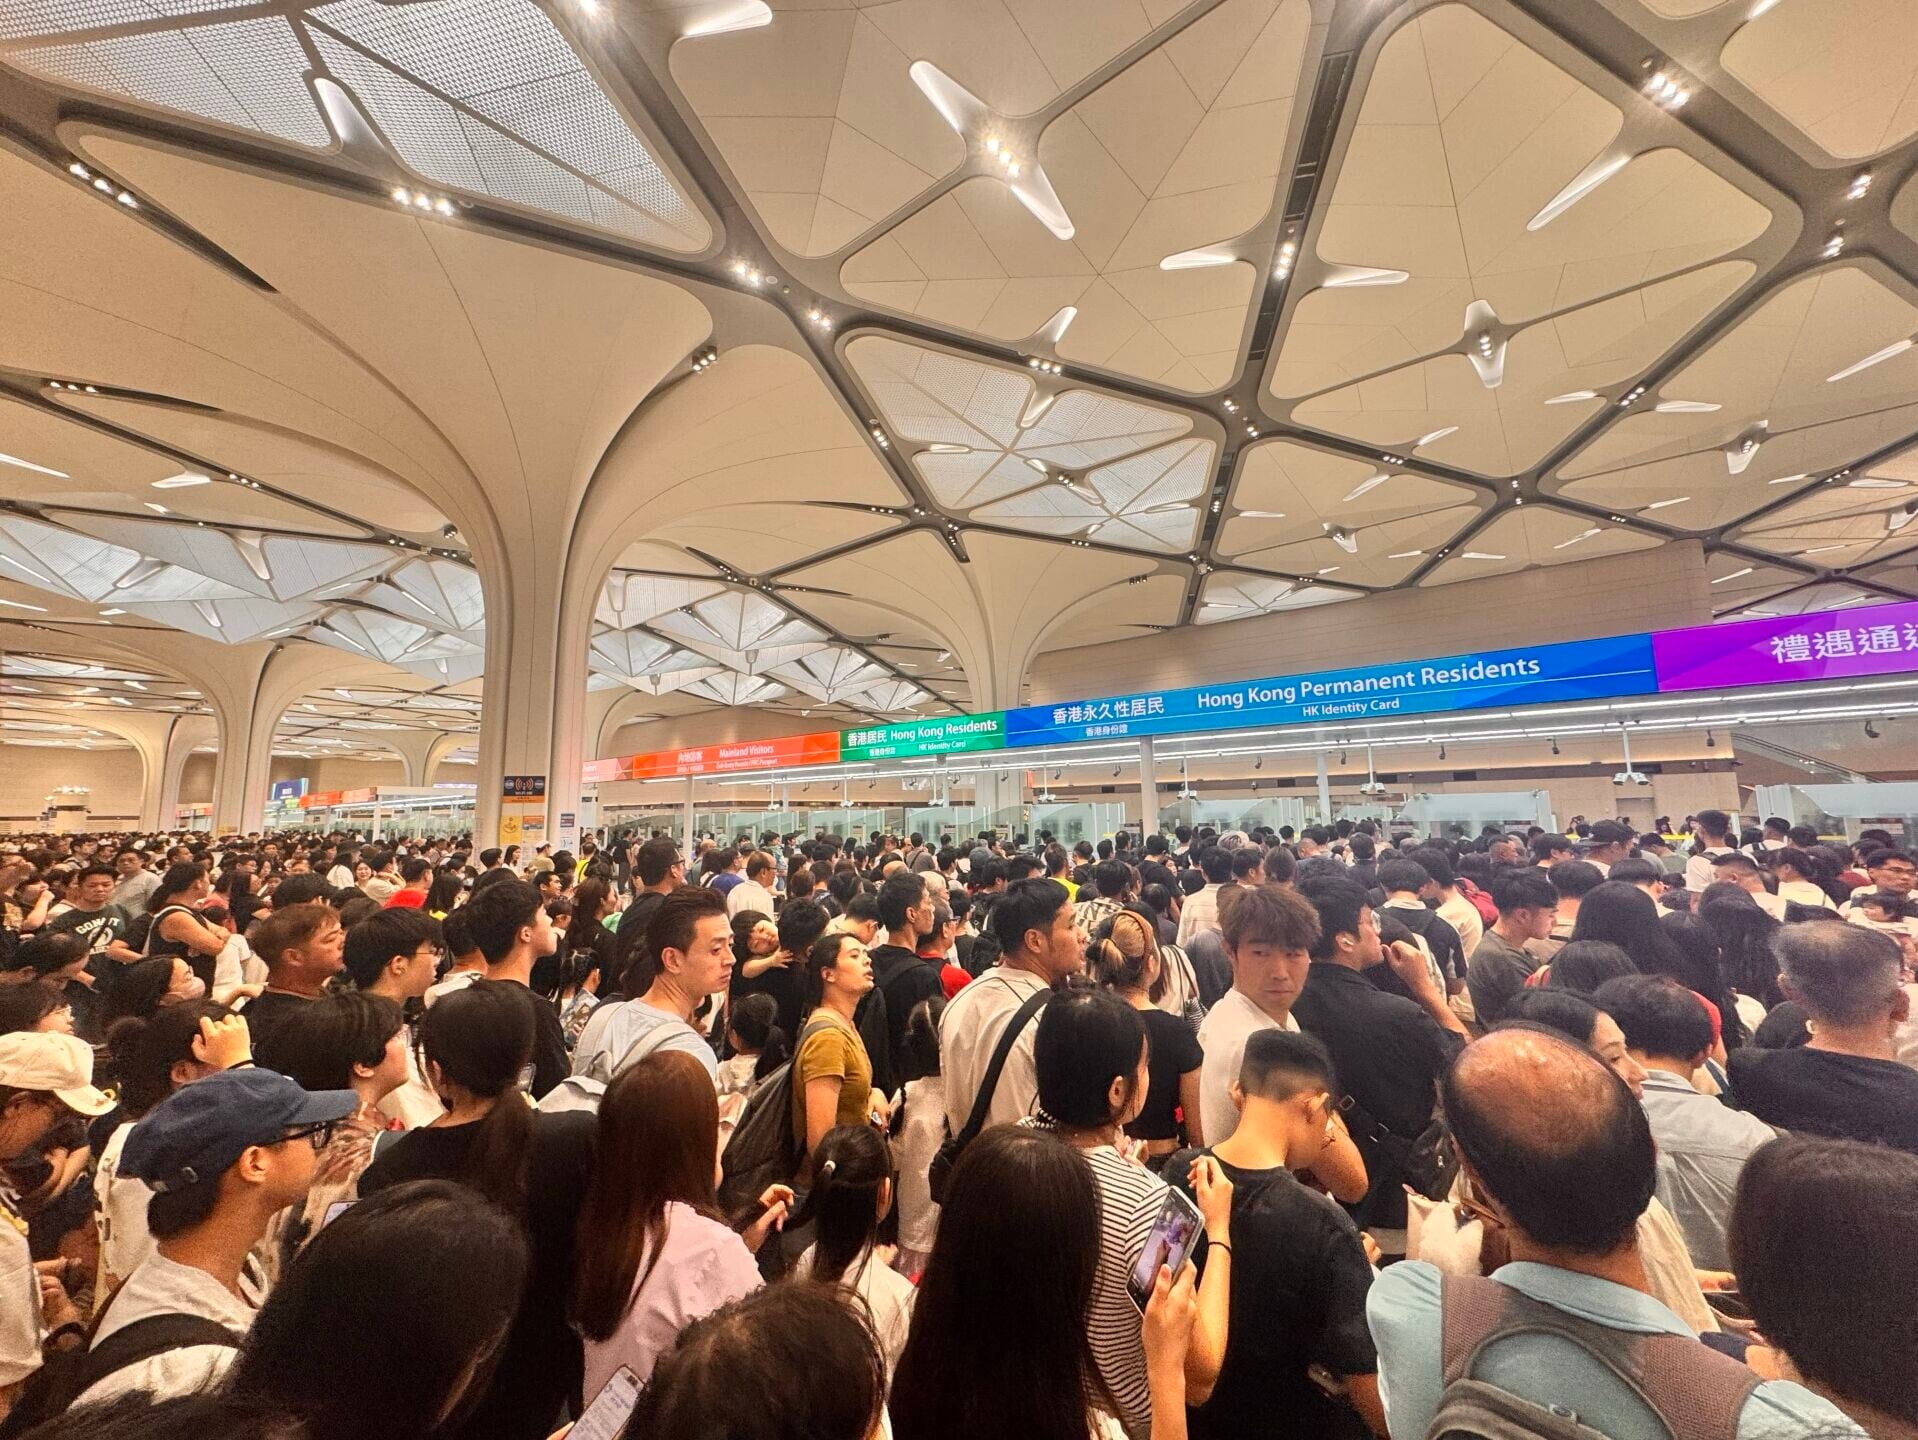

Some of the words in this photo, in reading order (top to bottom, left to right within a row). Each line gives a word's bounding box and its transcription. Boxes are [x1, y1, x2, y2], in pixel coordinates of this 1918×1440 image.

[1198, 692, 1243, 709] Hong
[1248, 686, 1295, 704] Kong
[1300, 671, 1415, 698] Permanent
[1421, 658, 1541, 685] Residents
[1053, 696, 1164, 725] 香港永久性居民
[1302, 705, 1319, 717] HK
[1322, 702, 1367, 715] Identity
[1370, 698, 1400, 711] Card
[847, 729, 887, 747] 香港居民
[890, 730, 916, 742] Hong
[918, 726, 944, 739] Kong
[945, 718, 998, 735] Residents
[1085, 723, 1128, 737] 香港身份證
[719, 747, 748, 758] Mainland
[750, 745, 775, 755] Visitors
[918, 743, 928, 751] HK
[928, 742, 950, 751] Identity
[951, 740, 966, 748] Card
